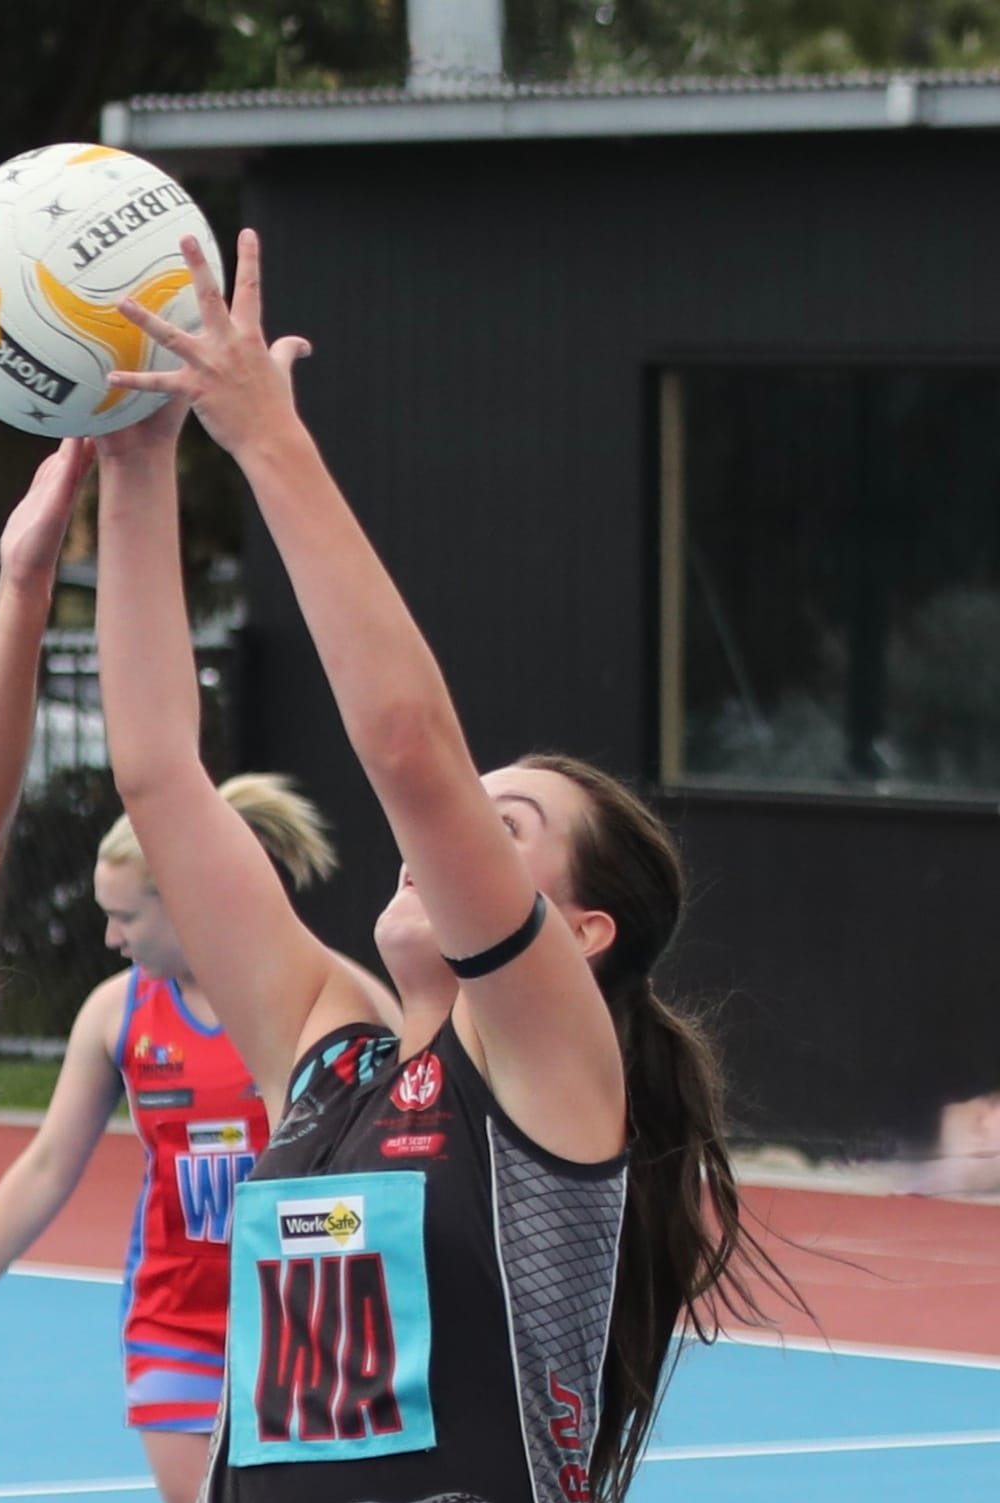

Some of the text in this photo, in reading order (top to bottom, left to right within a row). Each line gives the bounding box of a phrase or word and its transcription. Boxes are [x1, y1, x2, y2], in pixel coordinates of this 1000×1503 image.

[67, 182, 194, 271] ILBERT
[174, 1153, 256, 1244] W
[286, 1213, 355, 1234] WorkSafe
[256, 1253, 403, 1442] WA
